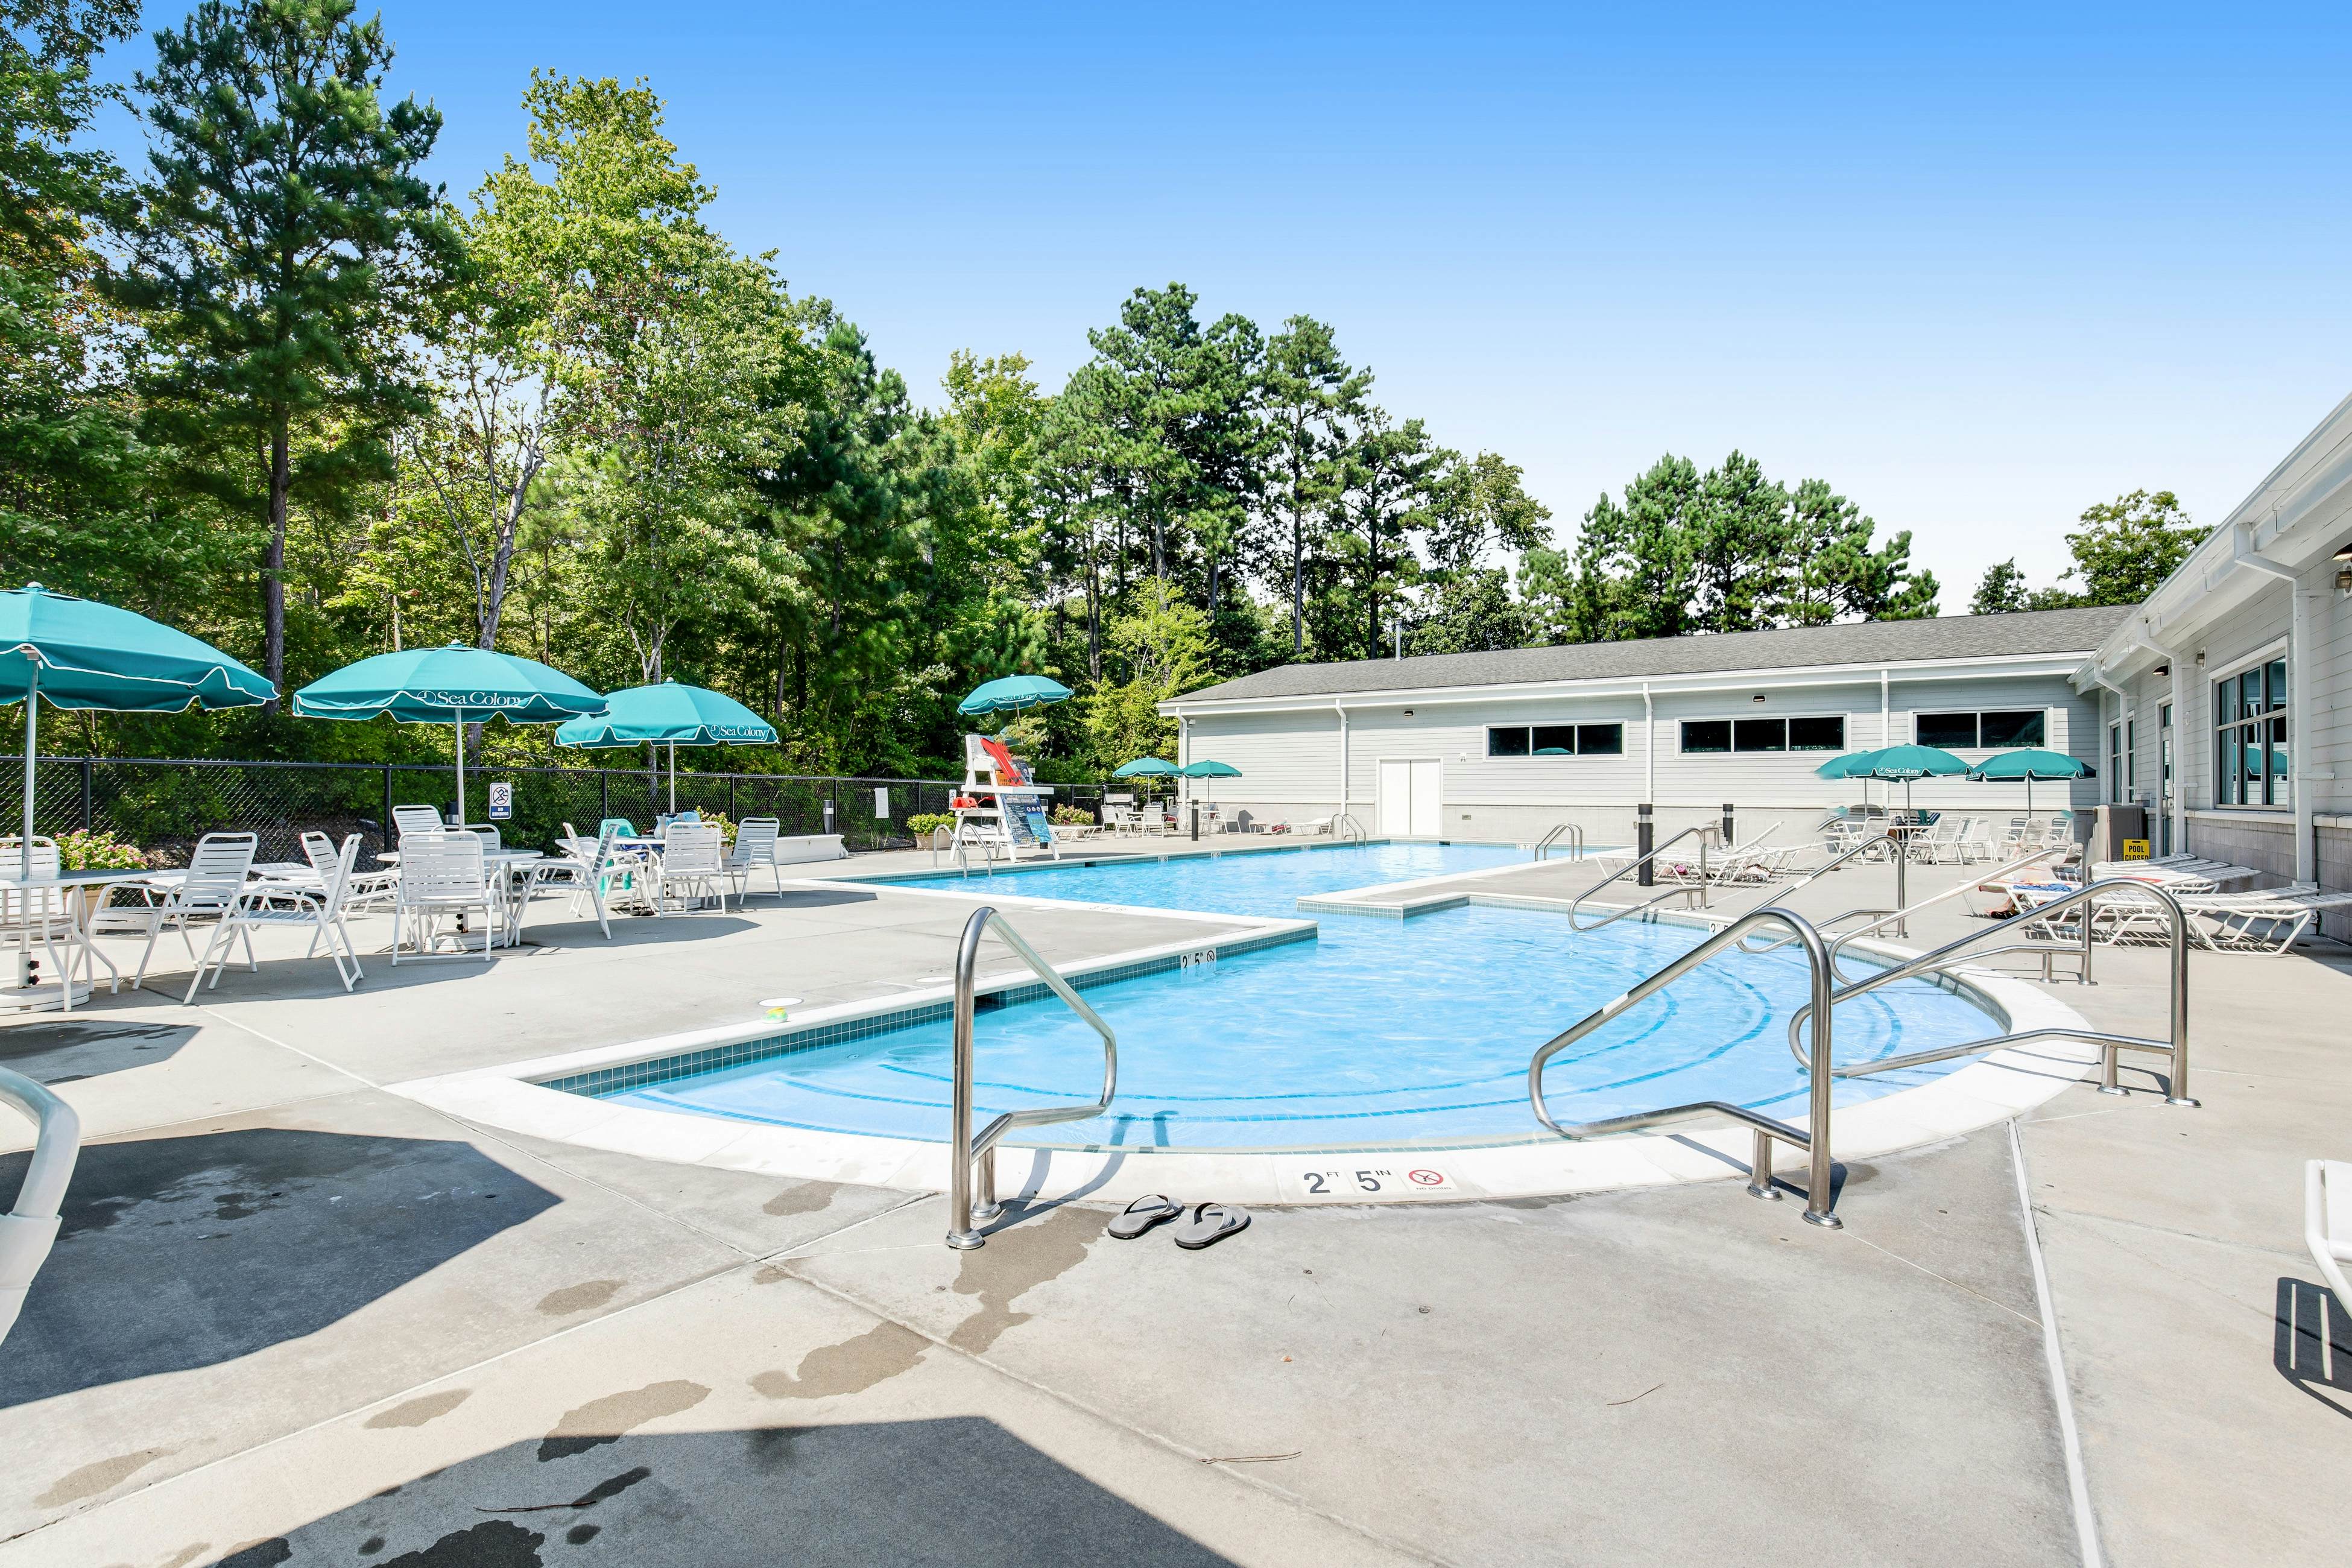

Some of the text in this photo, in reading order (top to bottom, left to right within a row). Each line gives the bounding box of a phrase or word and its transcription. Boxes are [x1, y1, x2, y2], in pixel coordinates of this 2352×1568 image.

[437, 691, 467, 704] Sea
[720, 725, 768, 740] Sea Colony
[1303, 1172, 1331, 1194] 2
[1355, 1171, 1381, 1192] 5
